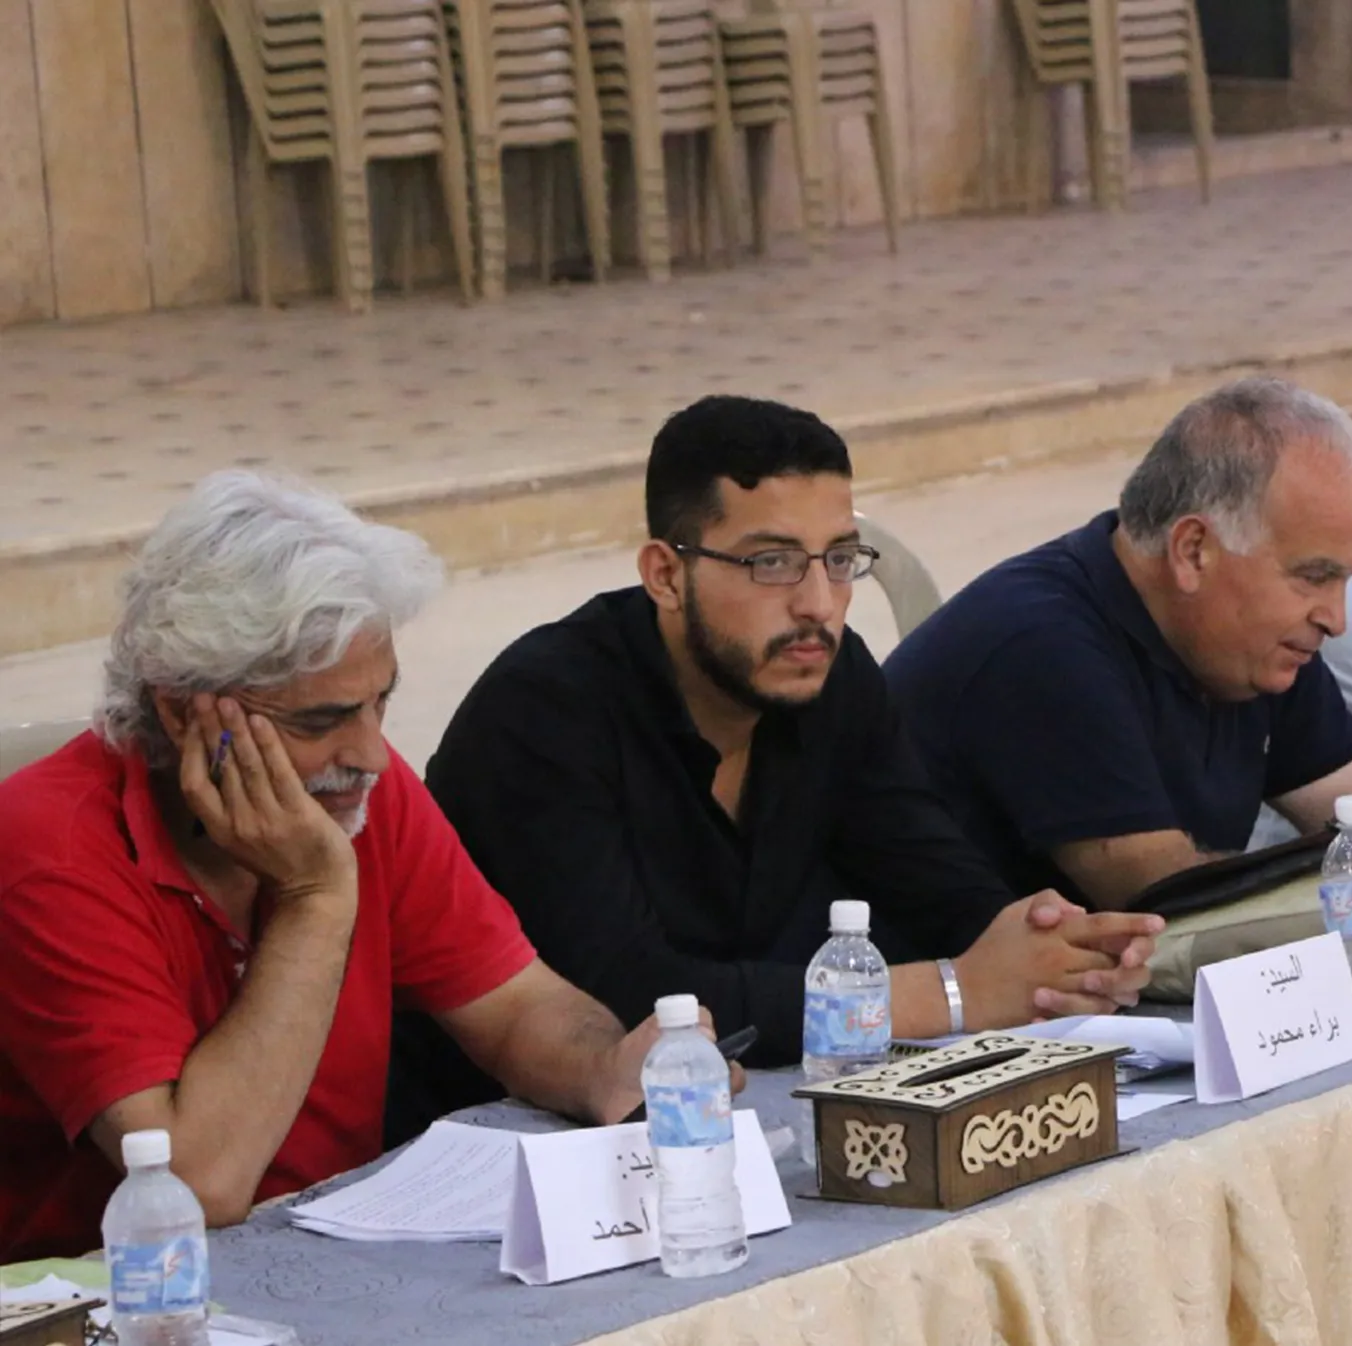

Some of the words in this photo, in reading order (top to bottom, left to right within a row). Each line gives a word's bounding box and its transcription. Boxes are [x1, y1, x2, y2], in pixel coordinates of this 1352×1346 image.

[1260, 954, 1304, 994] السيد:
[1258, 1027, 1305, 1056] محمود
[1309, 1009, 1340, 1042] براء
[591, 1197, 651, 1240] أحمد
